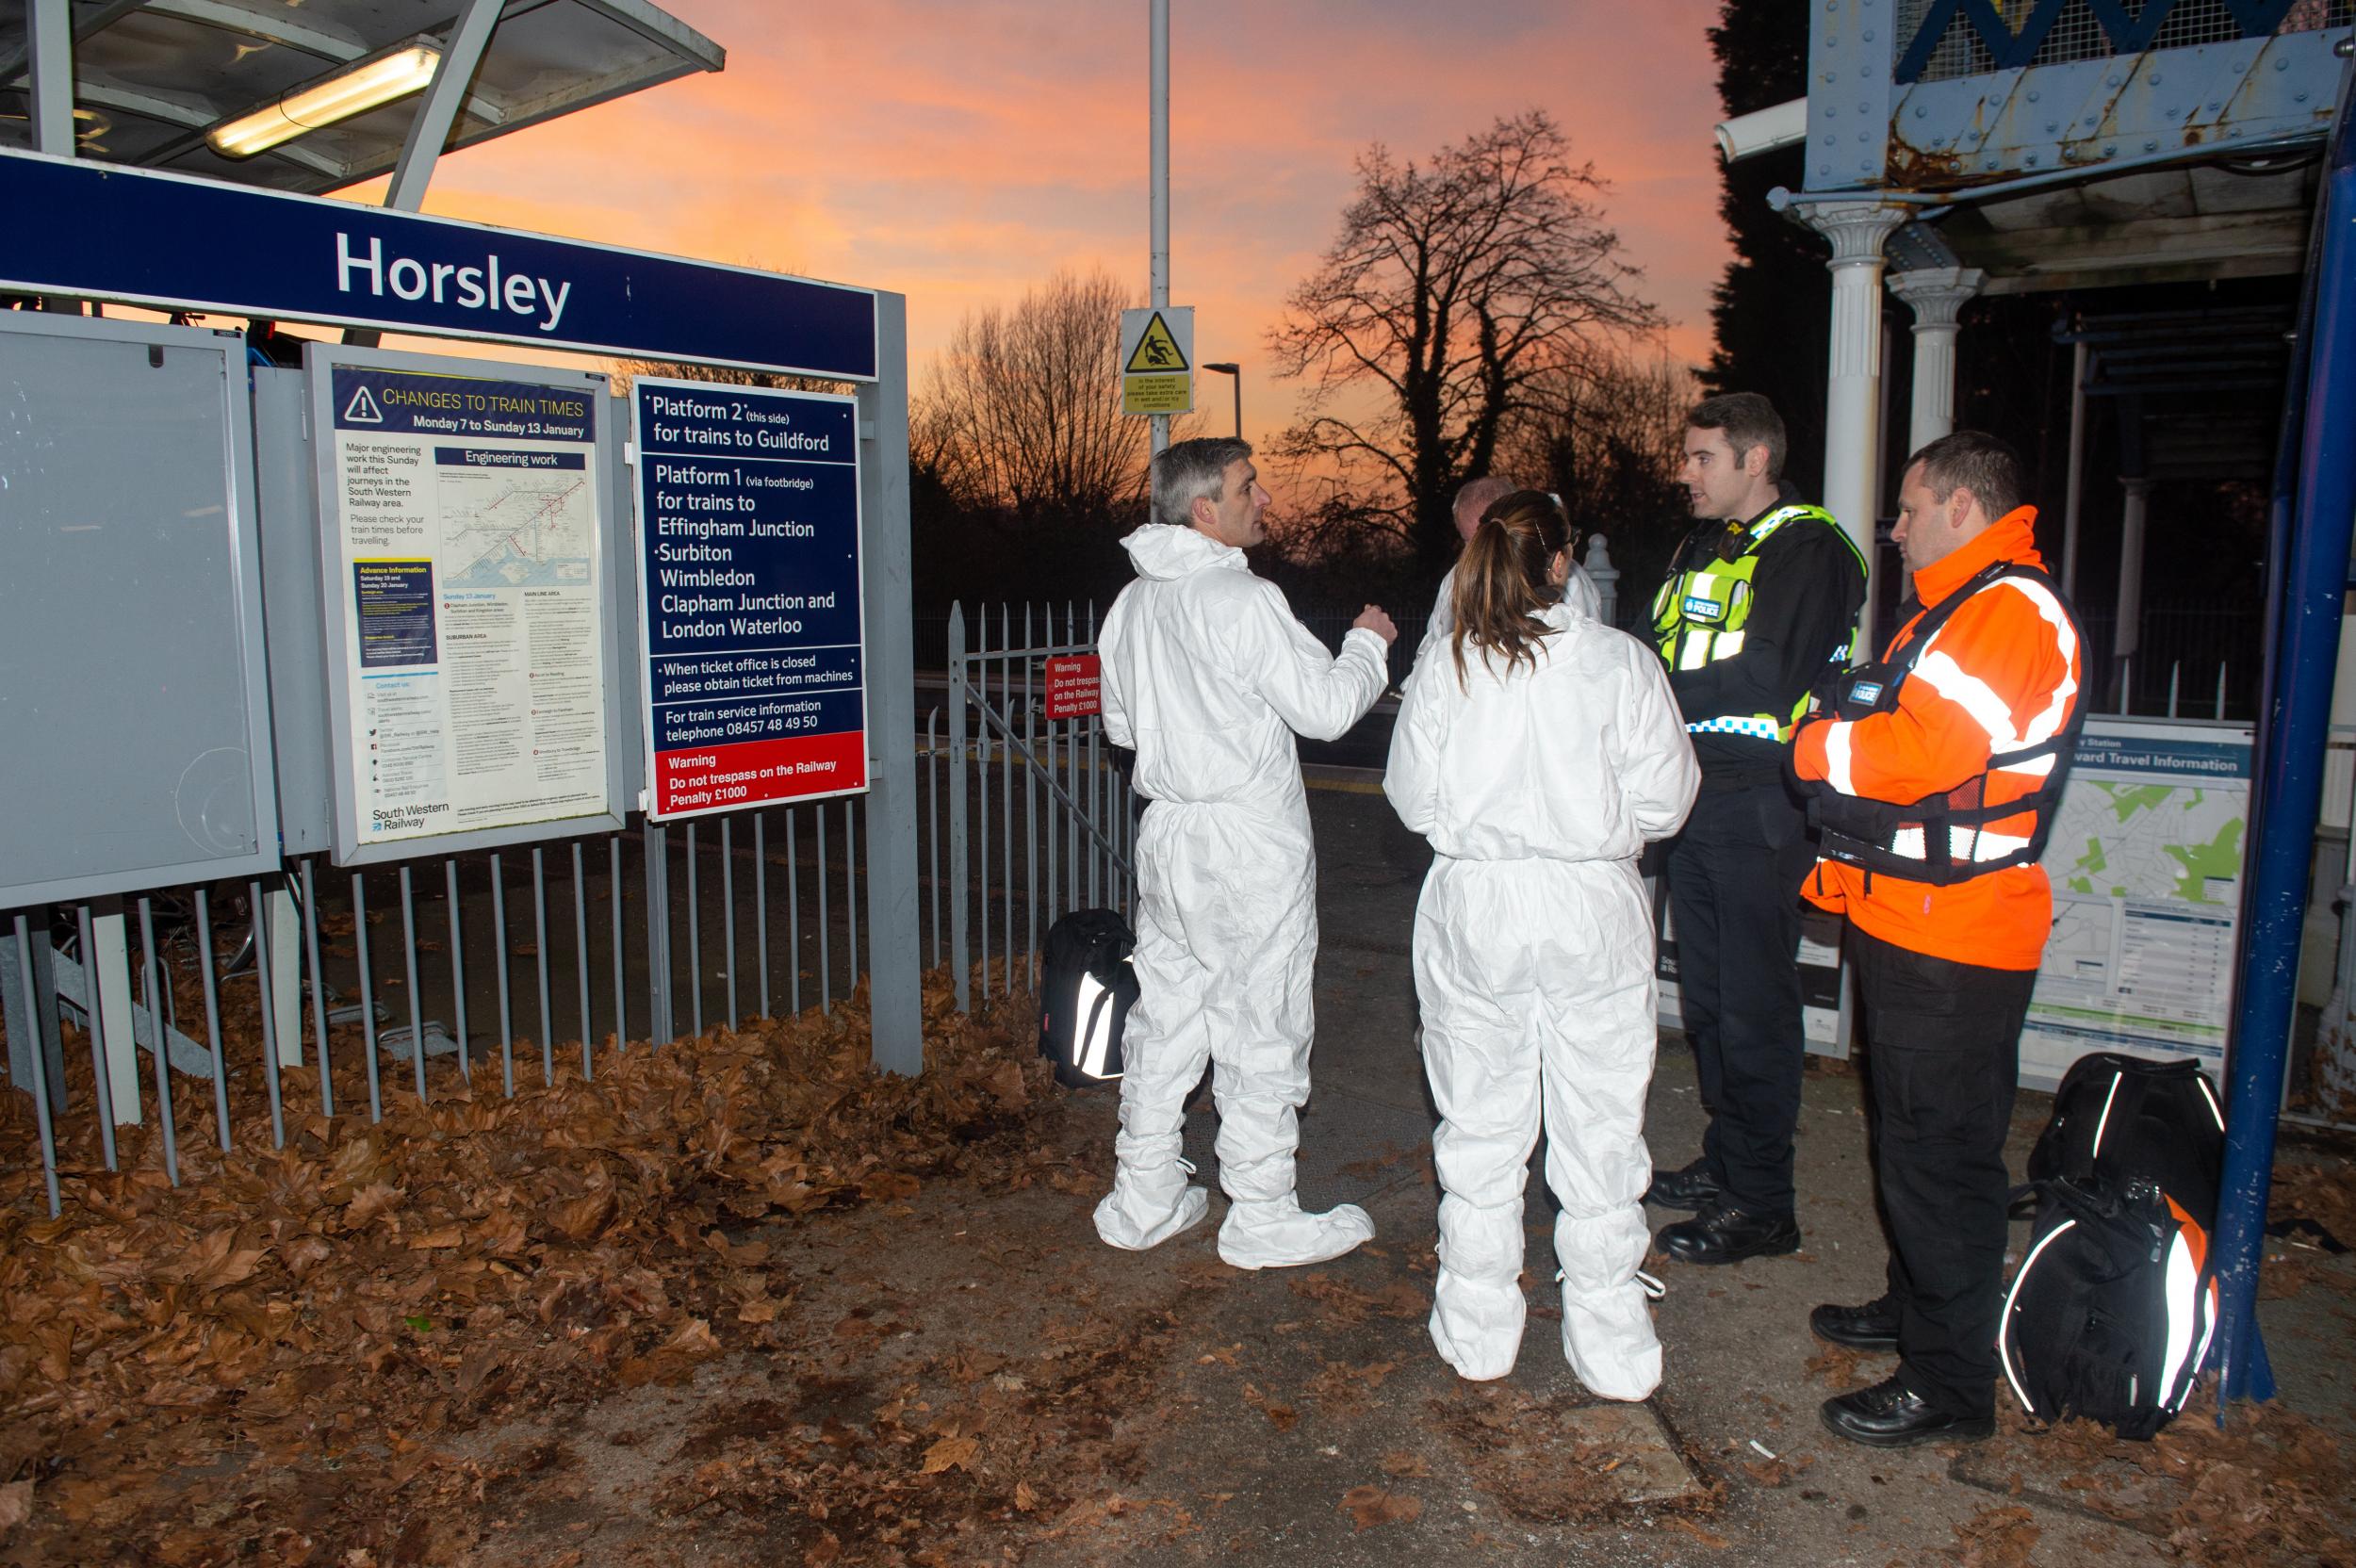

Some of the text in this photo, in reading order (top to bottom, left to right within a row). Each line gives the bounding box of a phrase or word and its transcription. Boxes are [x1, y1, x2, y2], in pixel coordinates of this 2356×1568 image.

[335, 231, 571, 333] Horsley
[383, 388, 583, 416] CHANGES TO TRAIN TIMES
[653, 397, 790, 424] Platform 2 (this side)
[414, 416, 583, 437] Monday 7 to Sunday 13 January
[654, 424, 829, 451] for trains to Guildford
[346, 444, 421, 456] Major engineering
[466, 450, 558, 466] Engineering work
[347, 454, 418, 466] work this Sunday
[347, 466, 388, 475] will affect
[656, 465, 813, 490] Platform 1 (via footbridge)
[347, 477, 382, 487] journeys
[394, 477, 410, 485] the
[348, 487, 411, 497] South Western
[657, 491, 755, 511] for trains to
[350, 498, 379, 509] Railway
[351, 514, 424, 526] Please check your
[658, 517, 814, 539] Effingham Junction
[372, 526, 394, 534] times
[396, 525, 423, 534] before
[352, 536, 389, 547] travelling.
[659, 544, 731, 562] Surbiton
[661, 569, 755, 587] Wimbledon
[662, 592, 835, 615] Clapham Junction and
[1693, 605, 1719, 616] POLICE
[663, 618, 802, 638] London Waterloo
[664, 655, 816, 676] When ticket office is closed
[1055, 663, 1081, 672] Warning
[664, 671, 853, 696] please obtain ticket from machines
[1055, 678, 1064, 688] Do
[1065, 678, 1075, 686] not
[1064, 691, 1074, 699] the
[1076, 689, 1099, 698] Railway
[666, 701, 821, 724] For train service information
[1055, 700, 1097, 713] Penalty £1000
[666, 715, 817, 743] telephone 08457 48 49 50
[2087, 739, 2121, 747] Station
[668, 755, 716, 770] Warning
[2074, 753, 2237, 771] ward Travel Information
[669, 760, 837, 790] Do not trespass on the Railway
[670, 787, 747, 806] Penalty £1000
[373, 808, 404, 821] South
[406, 802, 449, 817] Western
[384, 817, 425, 831] Railway
